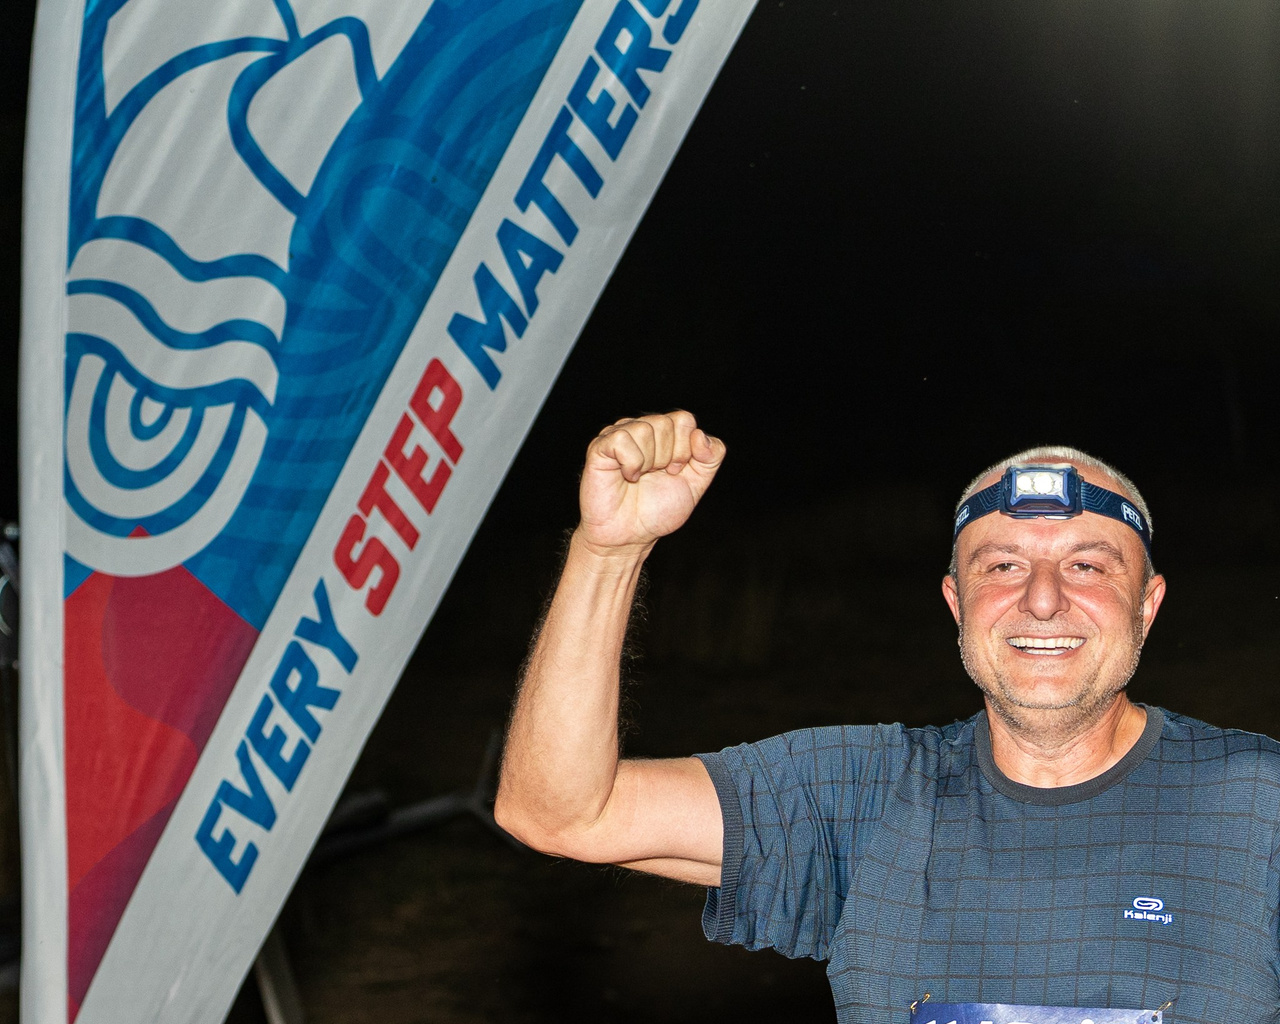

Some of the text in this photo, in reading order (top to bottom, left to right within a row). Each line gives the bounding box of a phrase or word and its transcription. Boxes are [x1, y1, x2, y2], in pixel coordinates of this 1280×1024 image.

[1123, 504, 1143, 530] PETZL
[195, 577, 359, 895] EVERY
[334, 358, 465, 617] STEP
[1123, 909, 1173, 925] Kalenji
